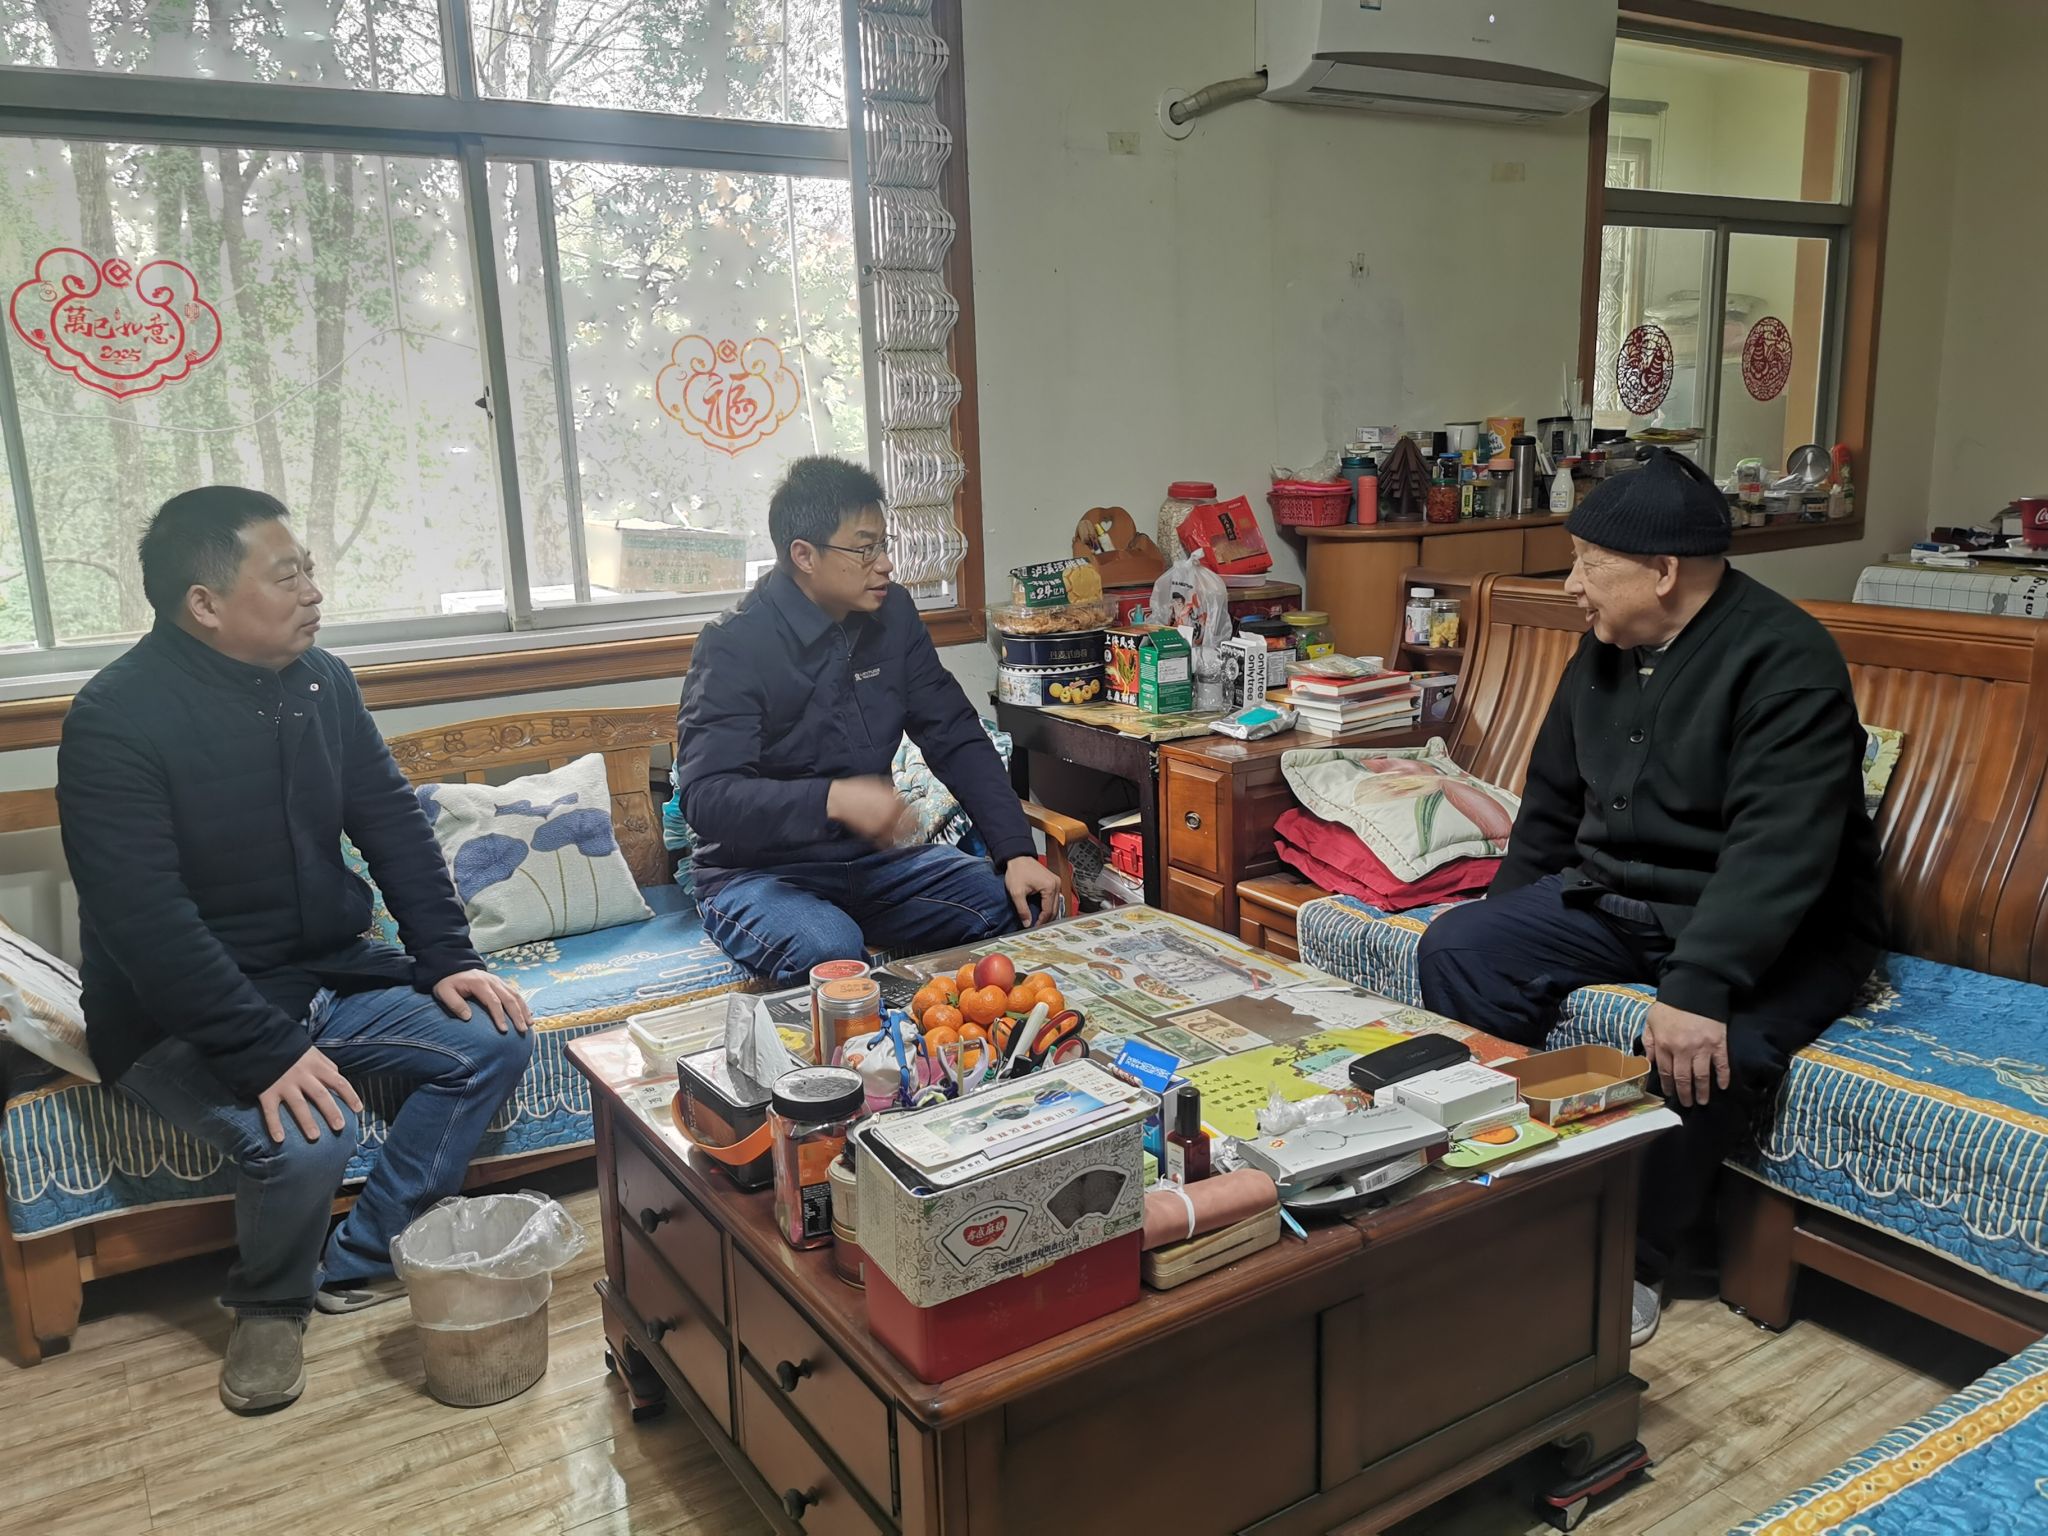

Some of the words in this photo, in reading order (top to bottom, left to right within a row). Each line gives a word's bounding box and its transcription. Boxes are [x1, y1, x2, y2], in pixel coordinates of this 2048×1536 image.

[99, 345, 142, 363] 2025
[1246, 654, 1256, 701] onlytree
[1256, 653, 1265, 699] onlytree
